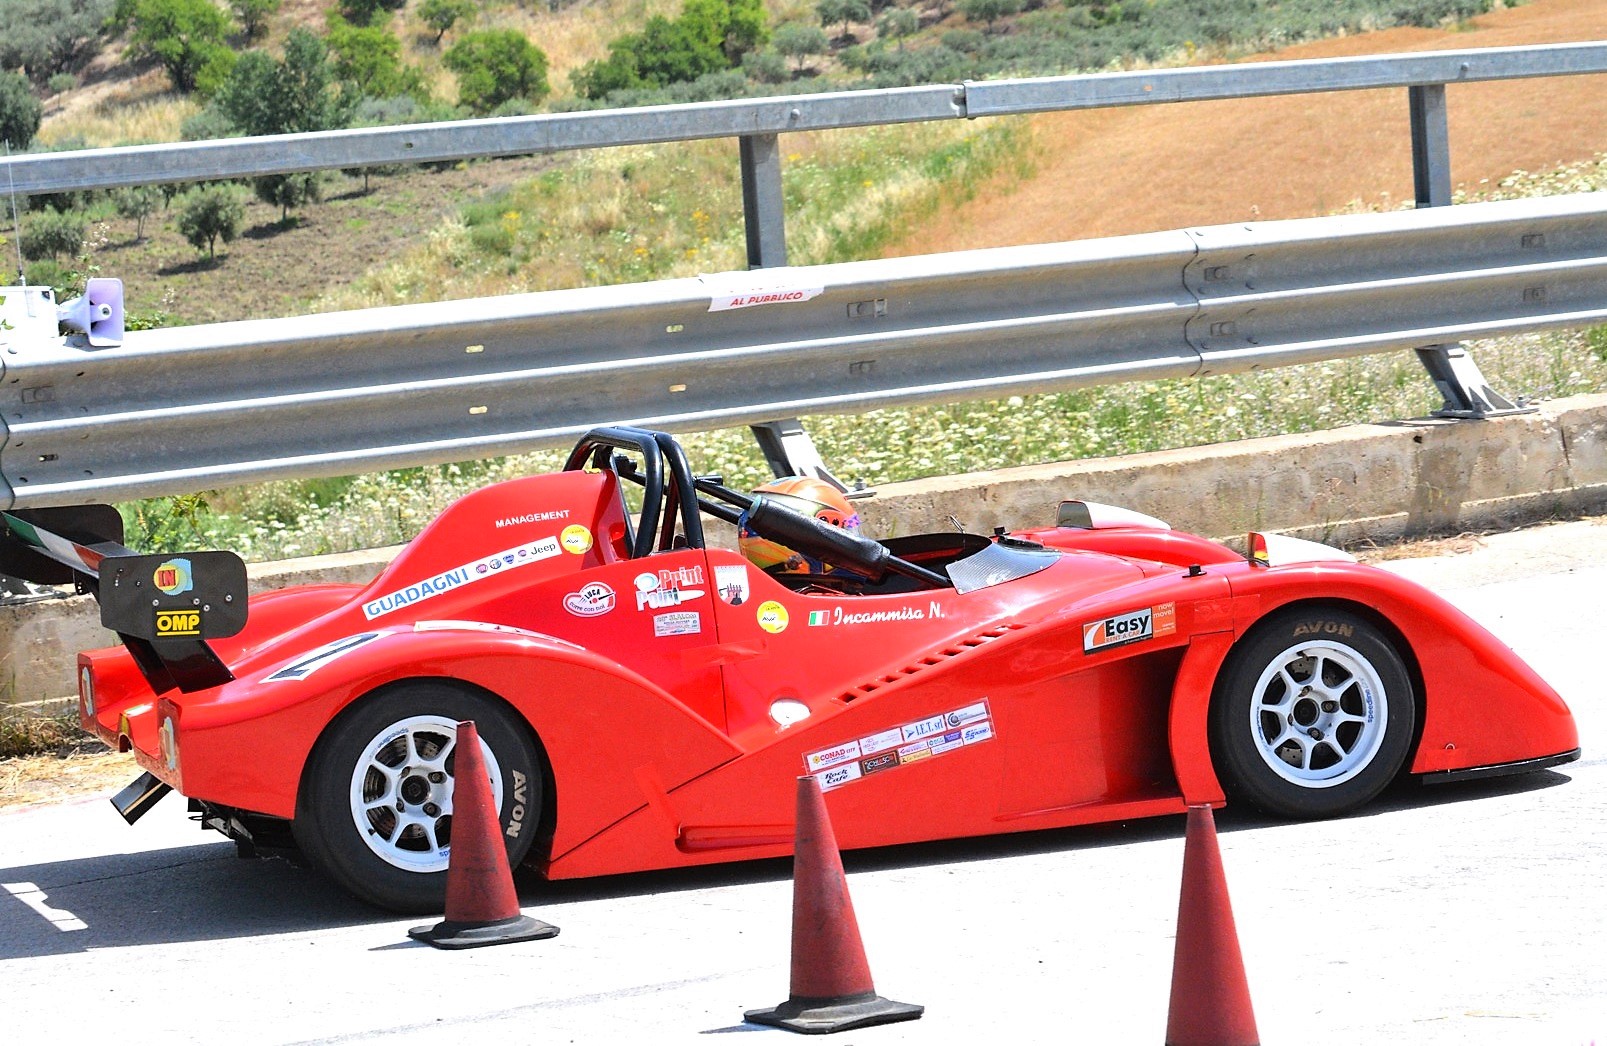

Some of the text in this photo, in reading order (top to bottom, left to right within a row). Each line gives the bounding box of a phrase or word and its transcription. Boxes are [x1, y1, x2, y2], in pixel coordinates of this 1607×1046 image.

[730, 291, 803, 307] AL PUBBLICO
[495, 509, 570, 528] MANAGEMENT
[530, 543, 556, 556] Jeep
[157, 569, 176, 587] IN
[659, 566, 704, 589] Print
[366, 568, 469, 617] GUADAGNI
[584, 588, 601, 600] LUCA
[636, 587, 681, 611] Point
[833, 600, 945, 626] Incammisa N.
[1153, 607, 1174, 619] move!
[1158, 602, 1174, 611] now
[156, 614, 200, 632] OMP
[1105, 614, 1151, 638] Easy
[1294, 621, 1354, 636] AVON
[820, 749, 846, 762] CONAD
[825, 769, 848, 780] Rock
[827, 774, 848, 784] Cafe
[506, 769, 527, 839] AVON
